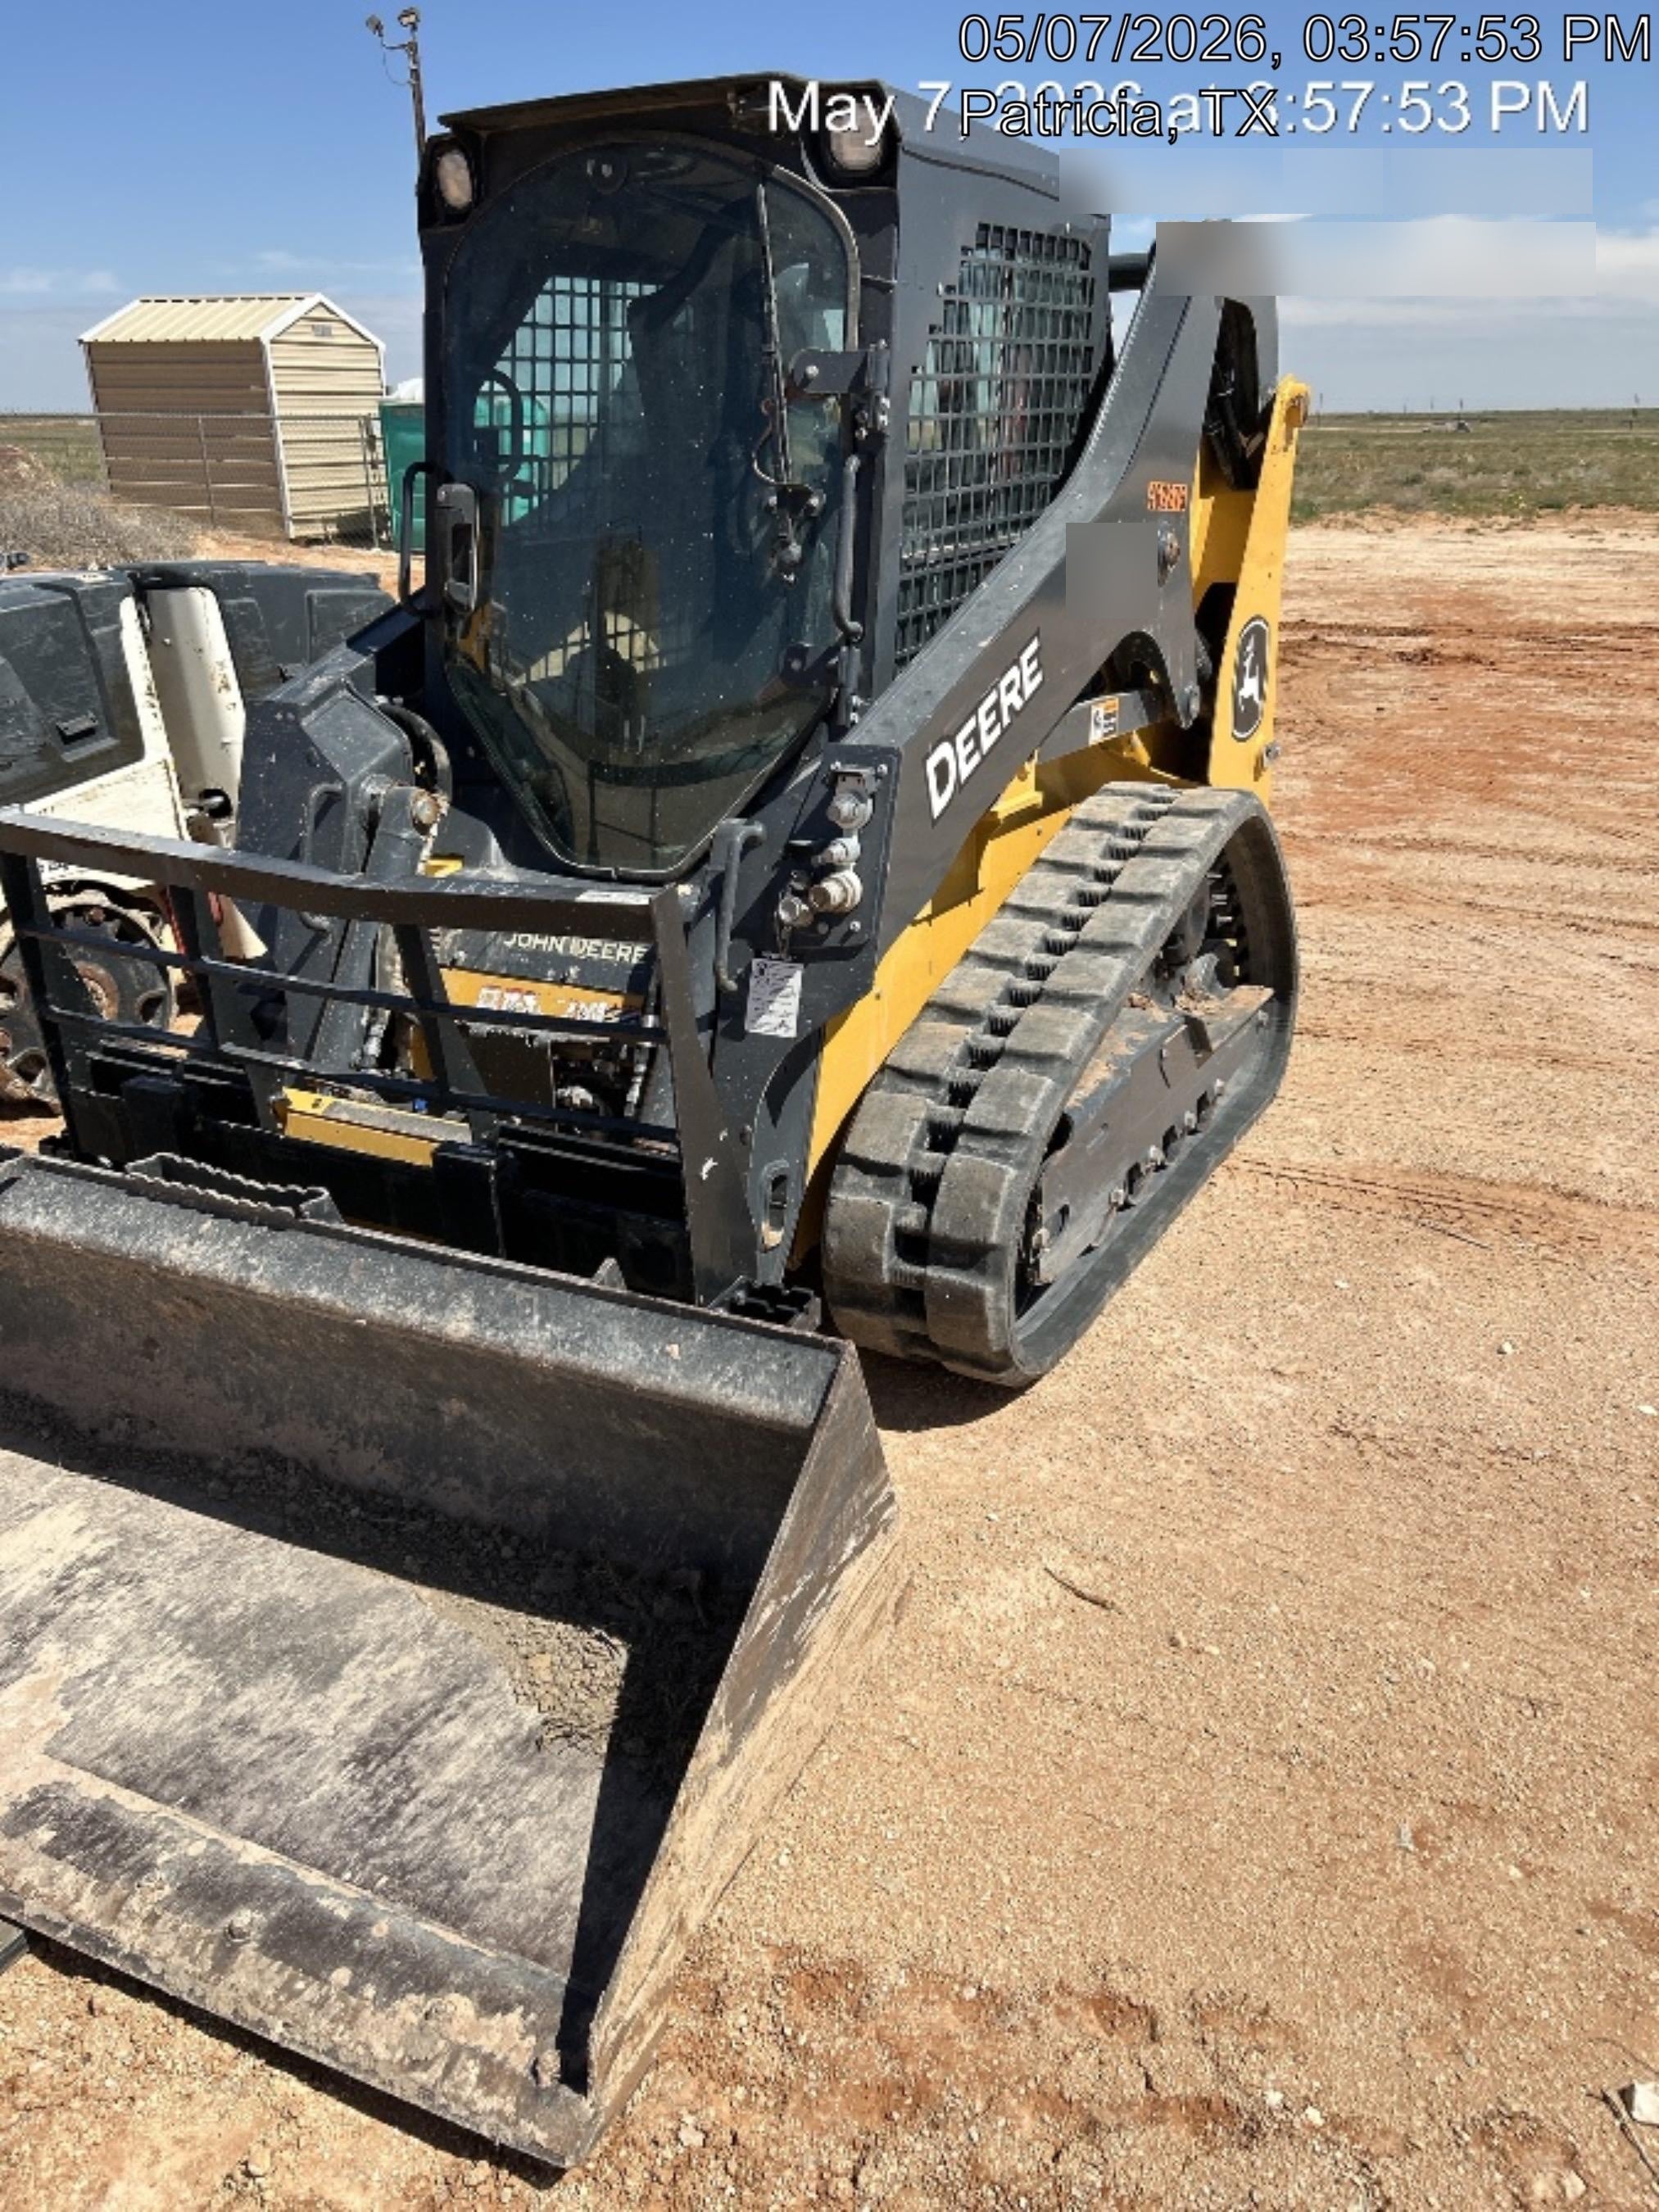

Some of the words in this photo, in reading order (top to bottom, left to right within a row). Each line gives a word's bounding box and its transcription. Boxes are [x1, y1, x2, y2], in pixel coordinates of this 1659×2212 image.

[926, 635, 1044, 820] DEERE
[503, 932, 564, 954] JOHN
[569, 936, 650, 964] DEERE
